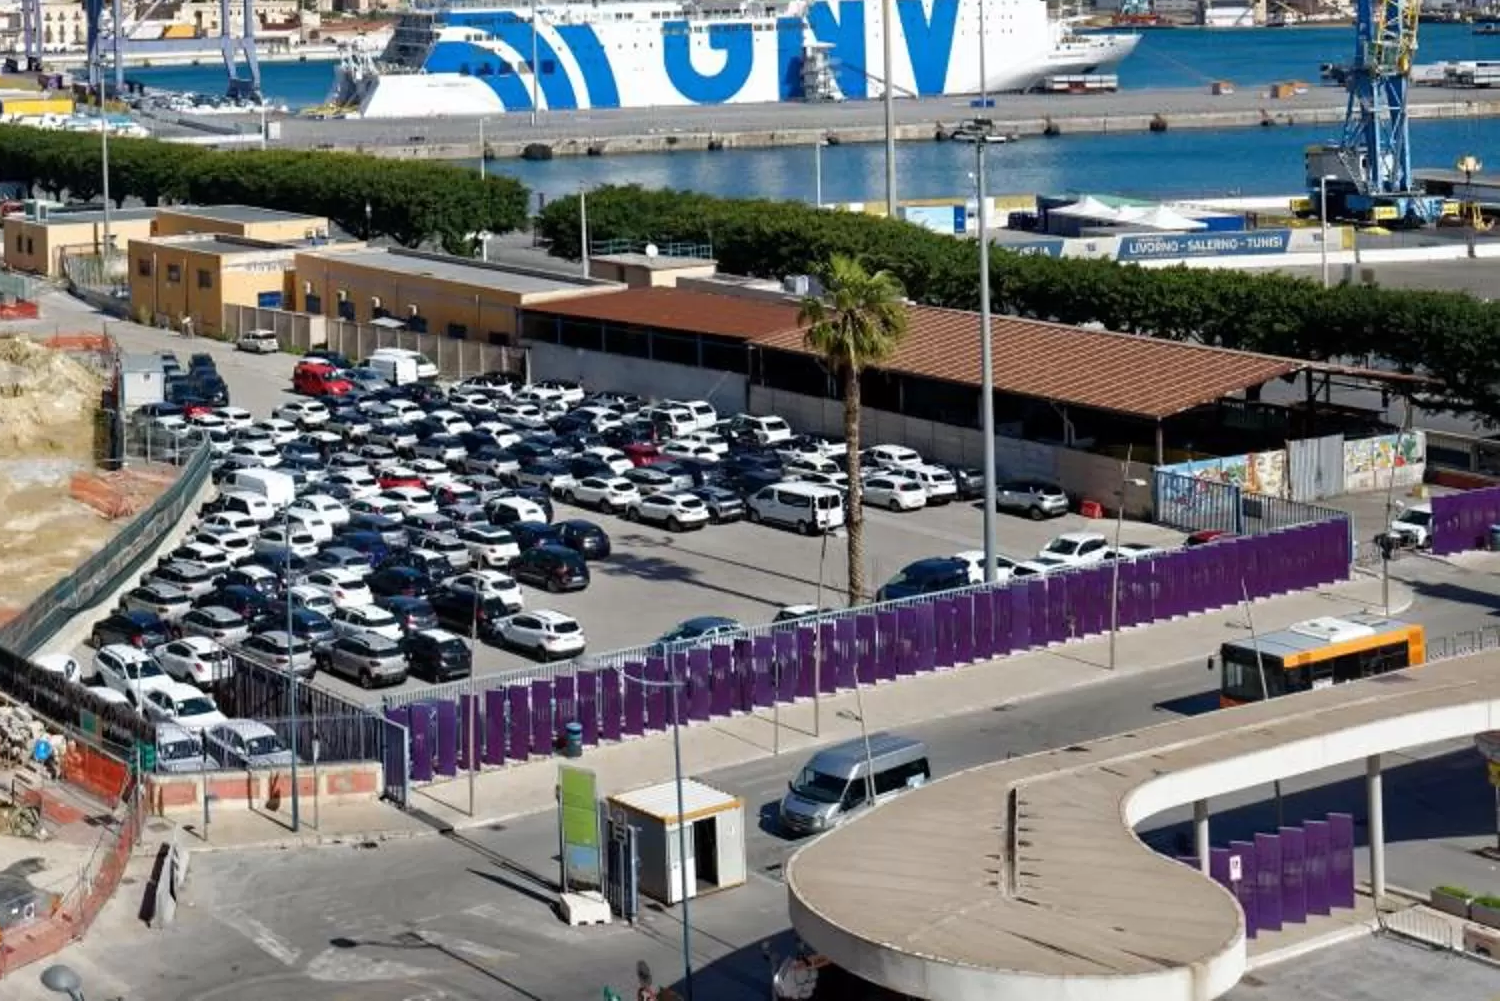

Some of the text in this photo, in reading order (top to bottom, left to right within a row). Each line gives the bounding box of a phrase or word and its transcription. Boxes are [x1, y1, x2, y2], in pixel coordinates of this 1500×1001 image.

[1129, 239, 1179, 254] LIVORNO
[1187, 238, 1238, 252] SALERNO
[1246, 235, 1283, 249] TUNISI
